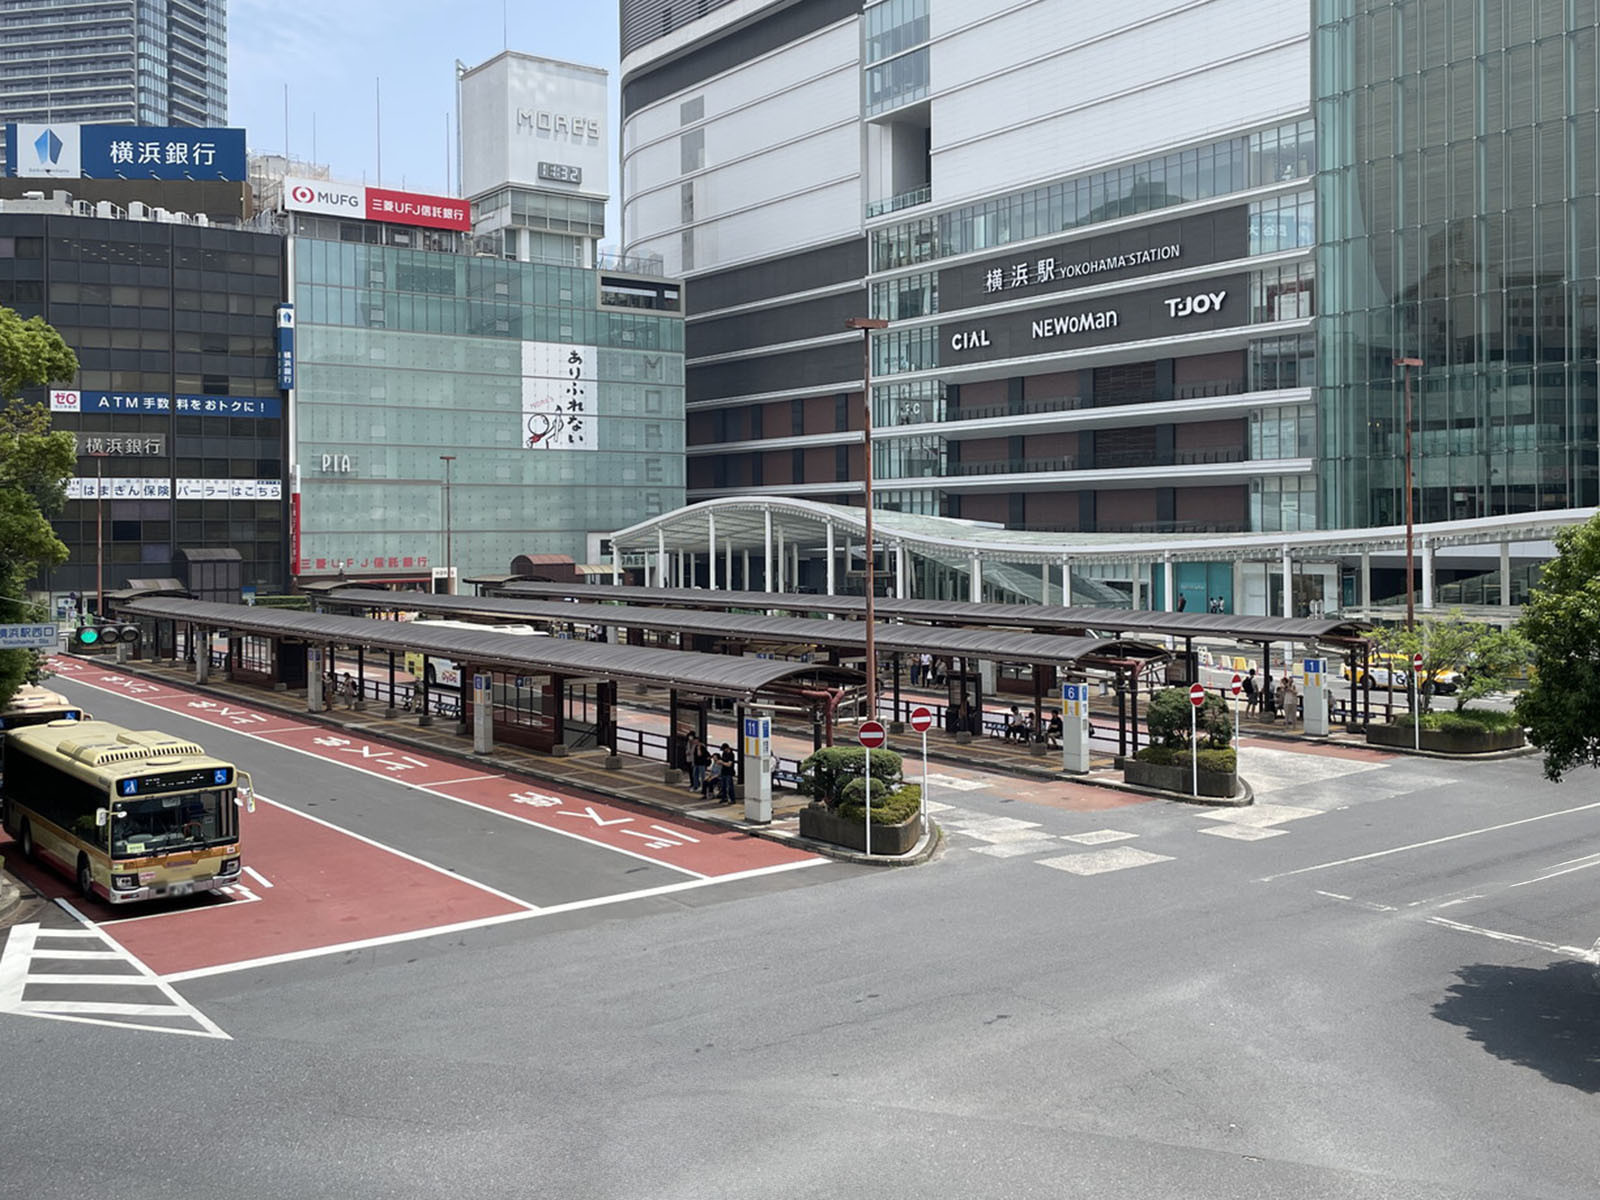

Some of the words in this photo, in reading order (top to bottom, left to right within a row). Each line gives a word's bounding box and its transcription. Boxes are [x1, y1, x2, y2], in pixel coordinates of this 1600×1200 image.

[110, 141, 216, 166] 横浜銀行
[317, 191, 359, 207] MUFG
[372, 199, 465, 221] 三菱UFJ信託銀行
[986, 258, 1054, 291] 横浜駅
[1060, 257, 1126, 278] YOKOHAMA
[1129, 244, 1180, 266] STATION
[951, 330, 991, 351] CIAL
[566, 350, 584, 443] ありふれない
[86, 438, 161, 455] 横浜銀行
[322, 454, 351, 472] PIA
[301, 556, 428, 569] 三菱UFJ信託銀行
[1068, 687, 1075, 699] 6
[748, 722, 756, 735] 11
